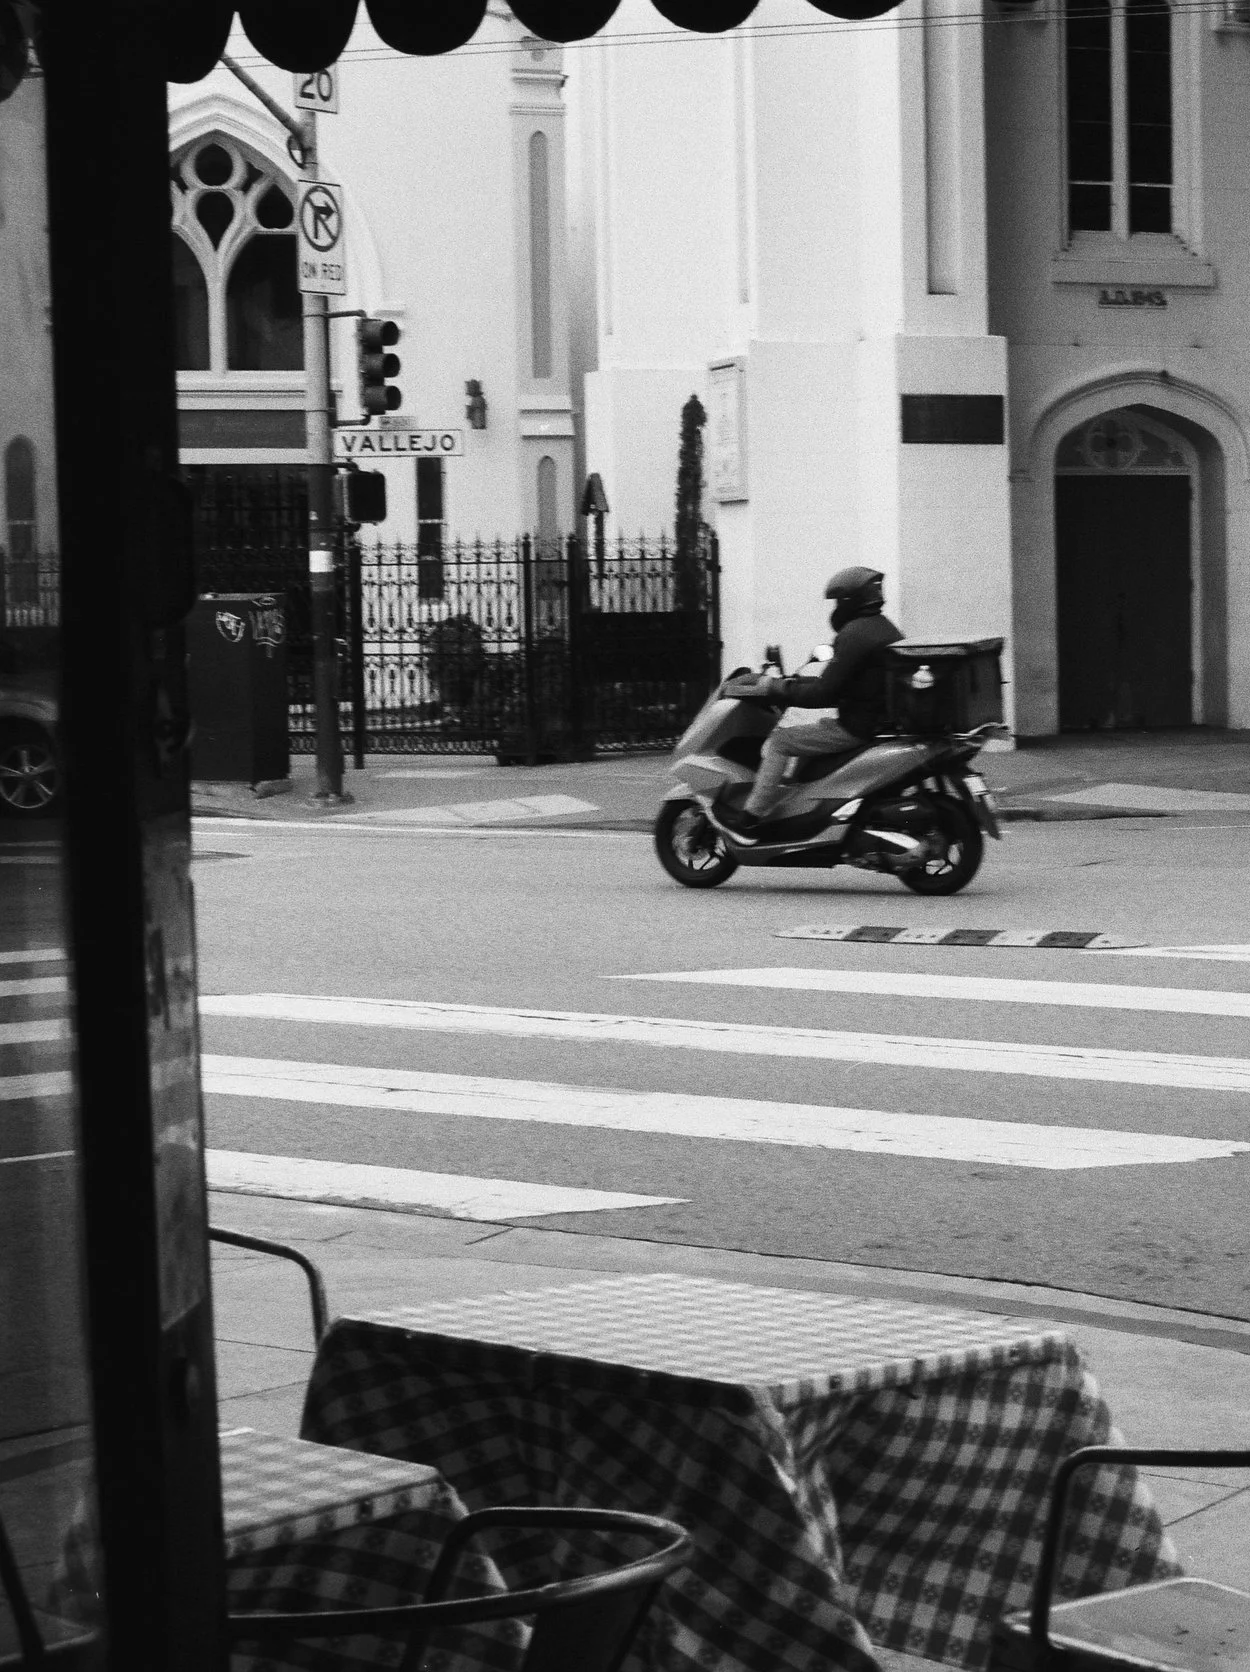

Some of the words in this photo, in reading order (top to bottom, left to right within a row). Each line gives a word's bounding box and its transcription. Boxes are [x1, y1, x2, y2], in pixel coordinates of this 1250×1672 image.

[299, 69, 333, 102] 20
[302, 261, 318, 278] ON
[321, 263, 342, 280] RED
[341, 434, 456, 452] VALLEJO
